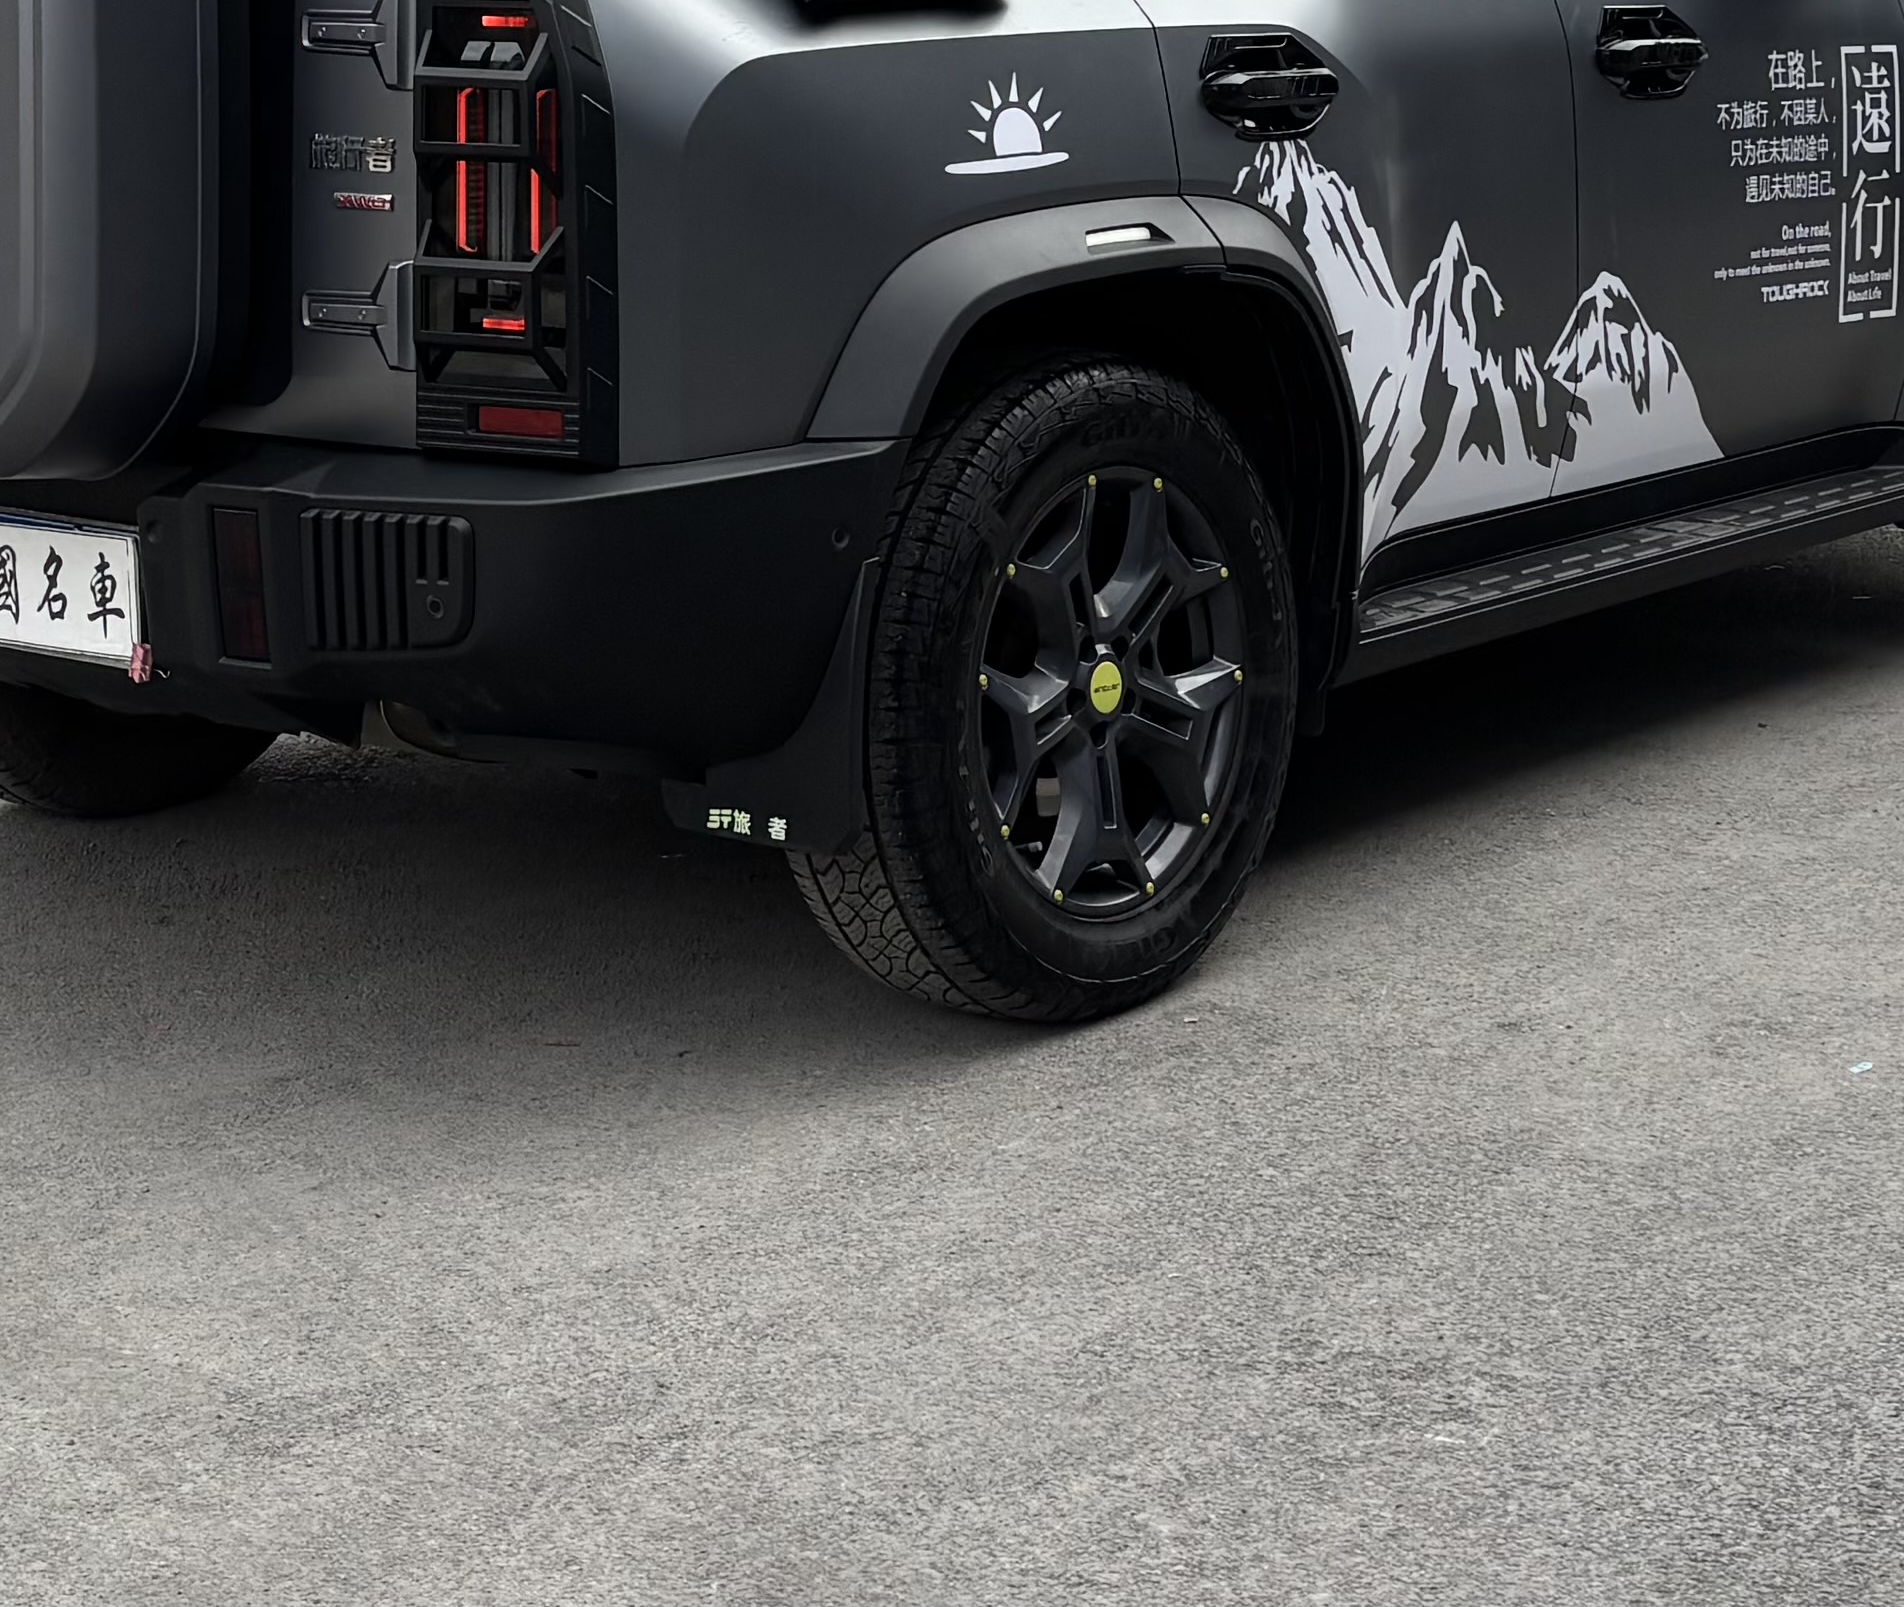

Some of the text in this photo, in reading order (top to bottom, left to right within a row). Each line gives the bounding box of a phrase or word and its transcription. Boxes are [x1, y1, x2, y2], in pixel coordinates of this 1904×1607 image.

[1782, 225, 1794, 241] On
[1795, 223, 1809, 238] the
[1847, 268, 1892, 285] About Travel
[1847, 286, 1882, 302] About Life
